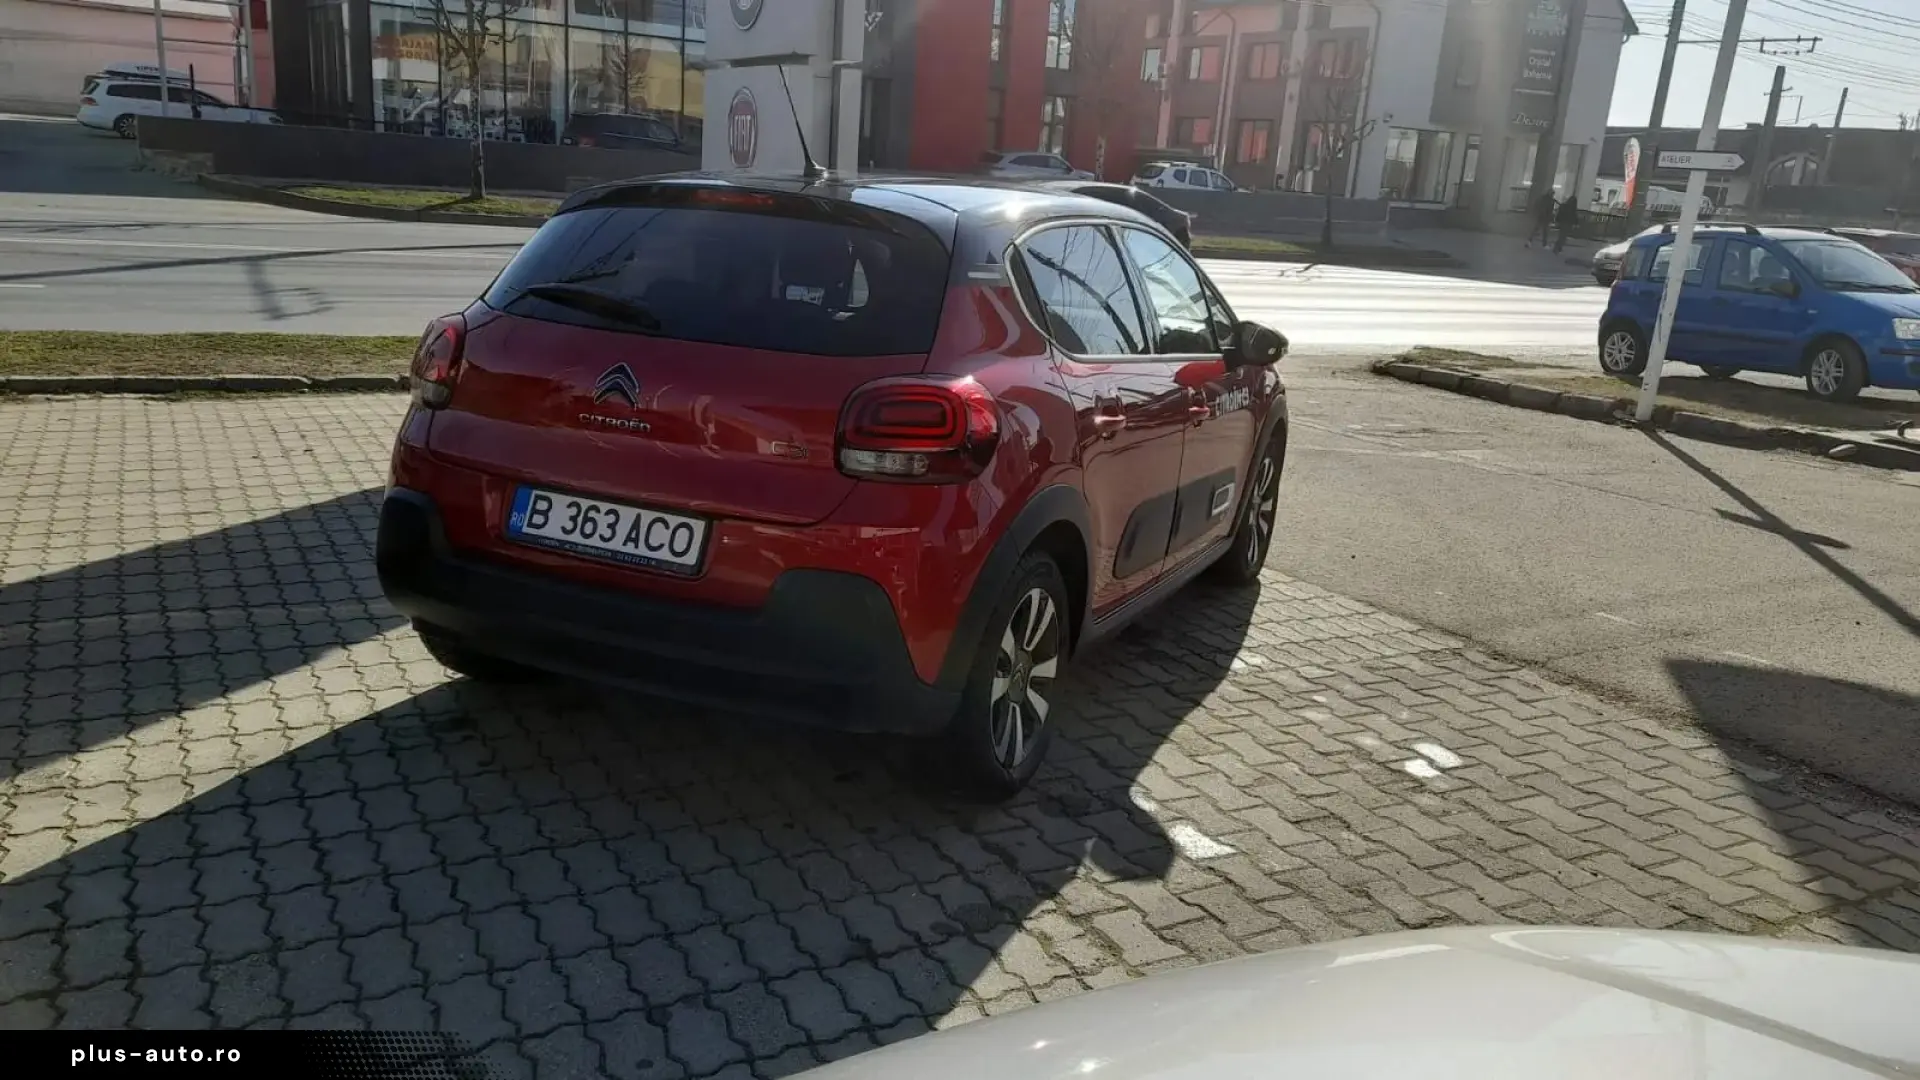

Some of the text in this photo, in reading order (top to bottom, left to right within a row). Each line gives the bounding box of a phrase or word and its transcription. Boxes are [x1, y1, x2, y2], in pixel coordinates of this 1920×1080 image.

[733, 114, 751, 151] FIAT
[1660, 155, 1692, 164] ATELIER
[578, 413, 651, 432] CITROËN
[510, 513, 525, 527] RO
[526, 493, 553, 530] B
[560, 501, 620, 543] 363
[622, 512, 695, 558] ACO
